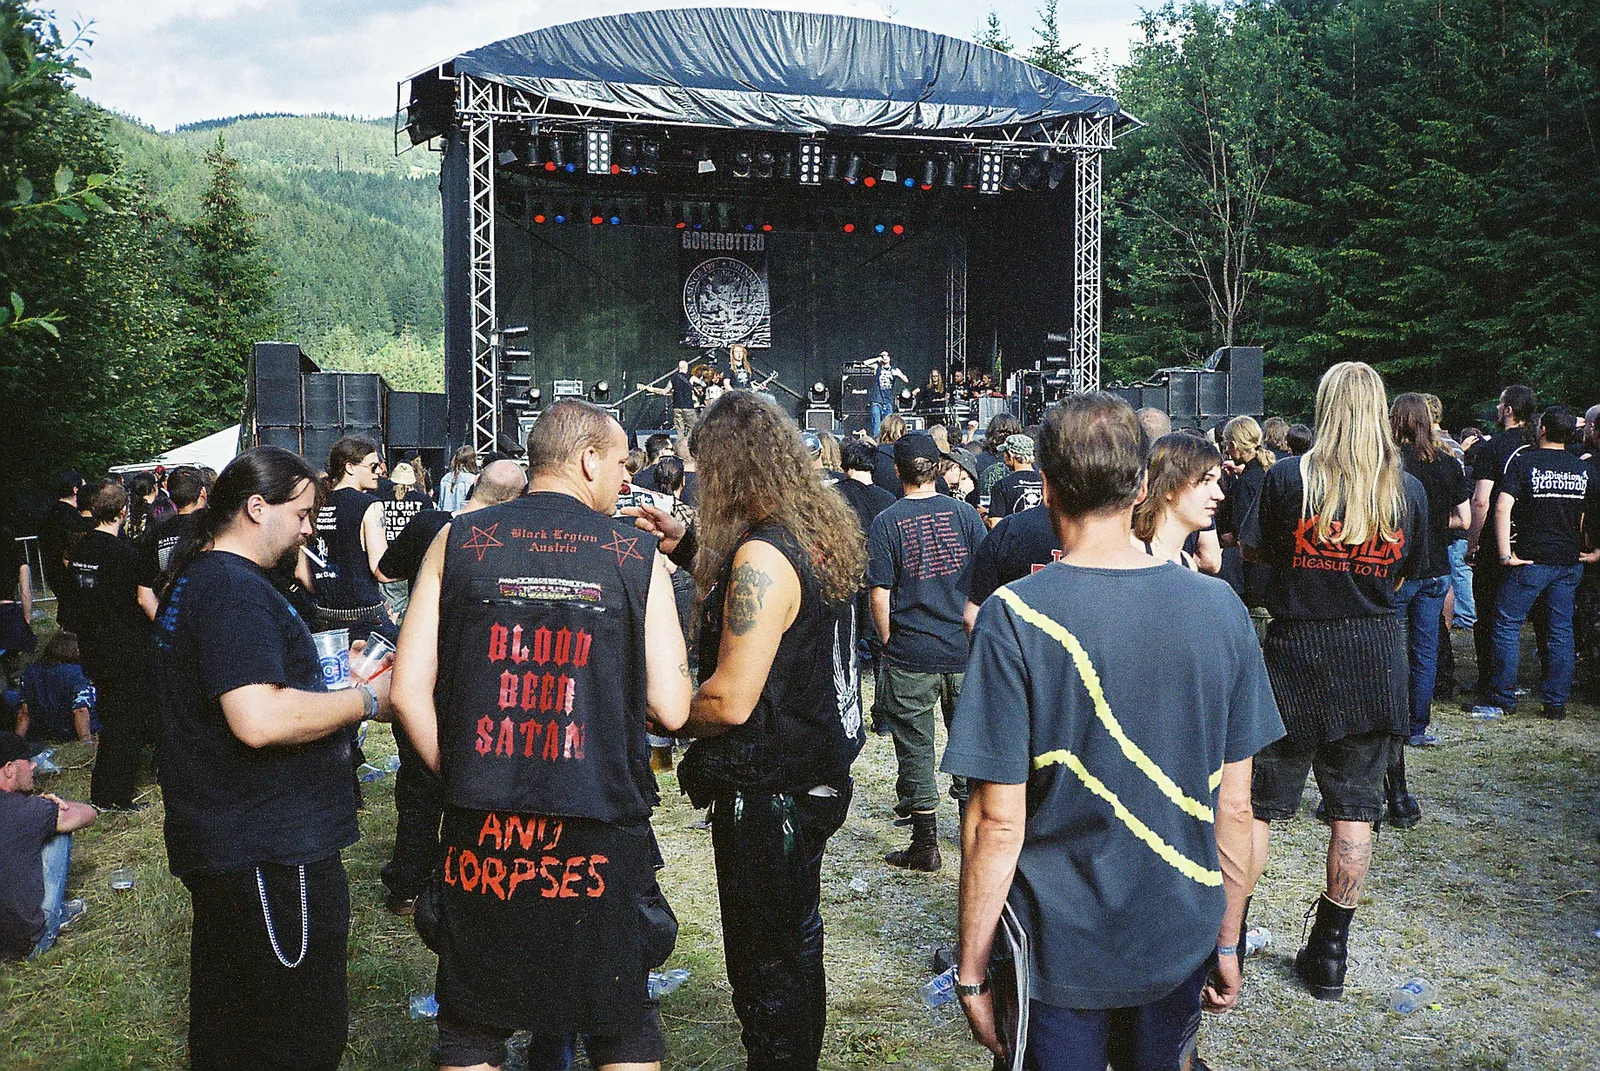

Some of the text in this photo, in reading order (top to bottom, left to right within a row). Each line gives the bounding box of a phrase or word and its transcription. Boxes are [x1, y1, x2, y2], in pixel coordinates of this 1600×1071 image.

[682, 230, 765, 251] GOREROTTED
[384, 501, 423, 511] FIGHT
[385, 516, 411, 526] RIG
[511, 528, 598, 543] Black Legion
[529, 542, 578, 554] Austria
[487, 621, 592, 670] BLOOD
[497, 668, 576, 716] BEER
[475, 714, 585, 763] SATAN
[478, 812, 564, 852] AND
[444, 846, 609, 900] CORPSES
